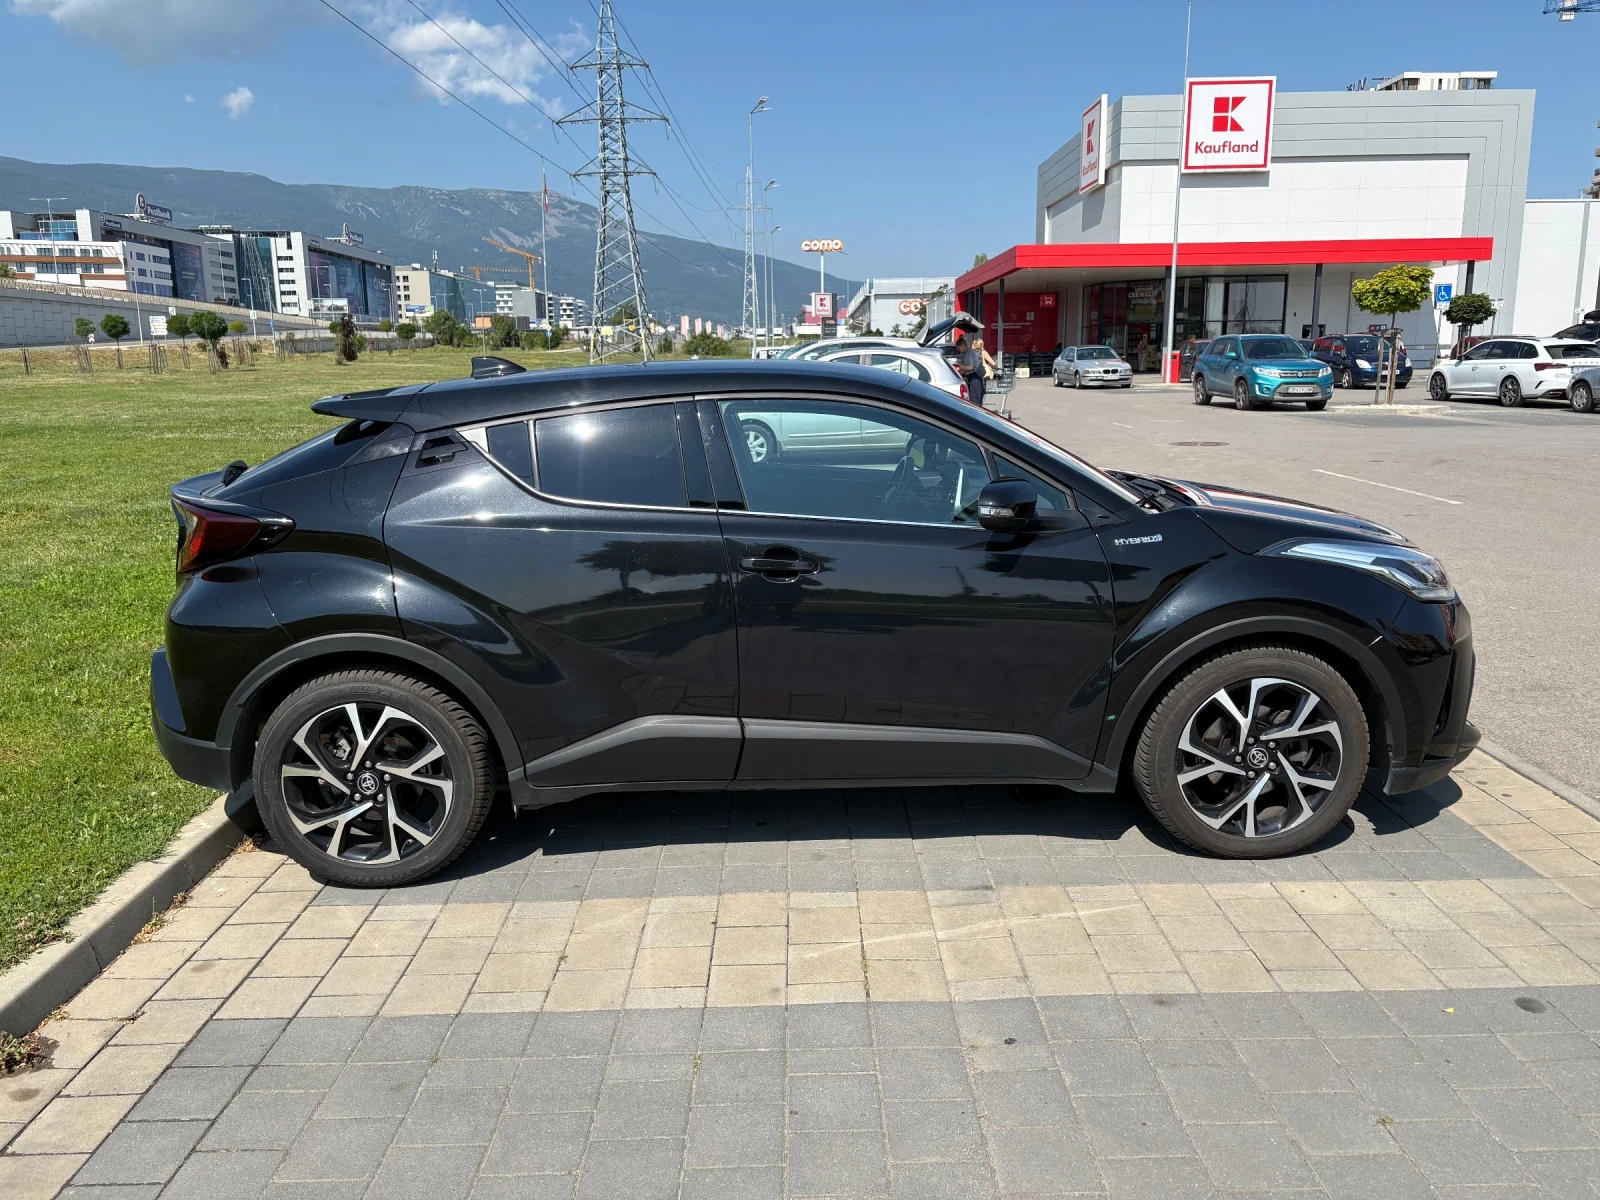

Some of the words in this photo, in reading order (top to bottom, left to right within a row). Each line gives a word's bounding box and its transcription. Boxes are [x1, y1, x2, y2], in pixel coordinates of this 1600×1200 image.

[1194, 139, 1259, 154] Kaufland
[1082, 156, 1098, 176] Kaufland
[146, 205, 171, 219] Postbank
[1114, 536, 1155, 546] HYBRID
